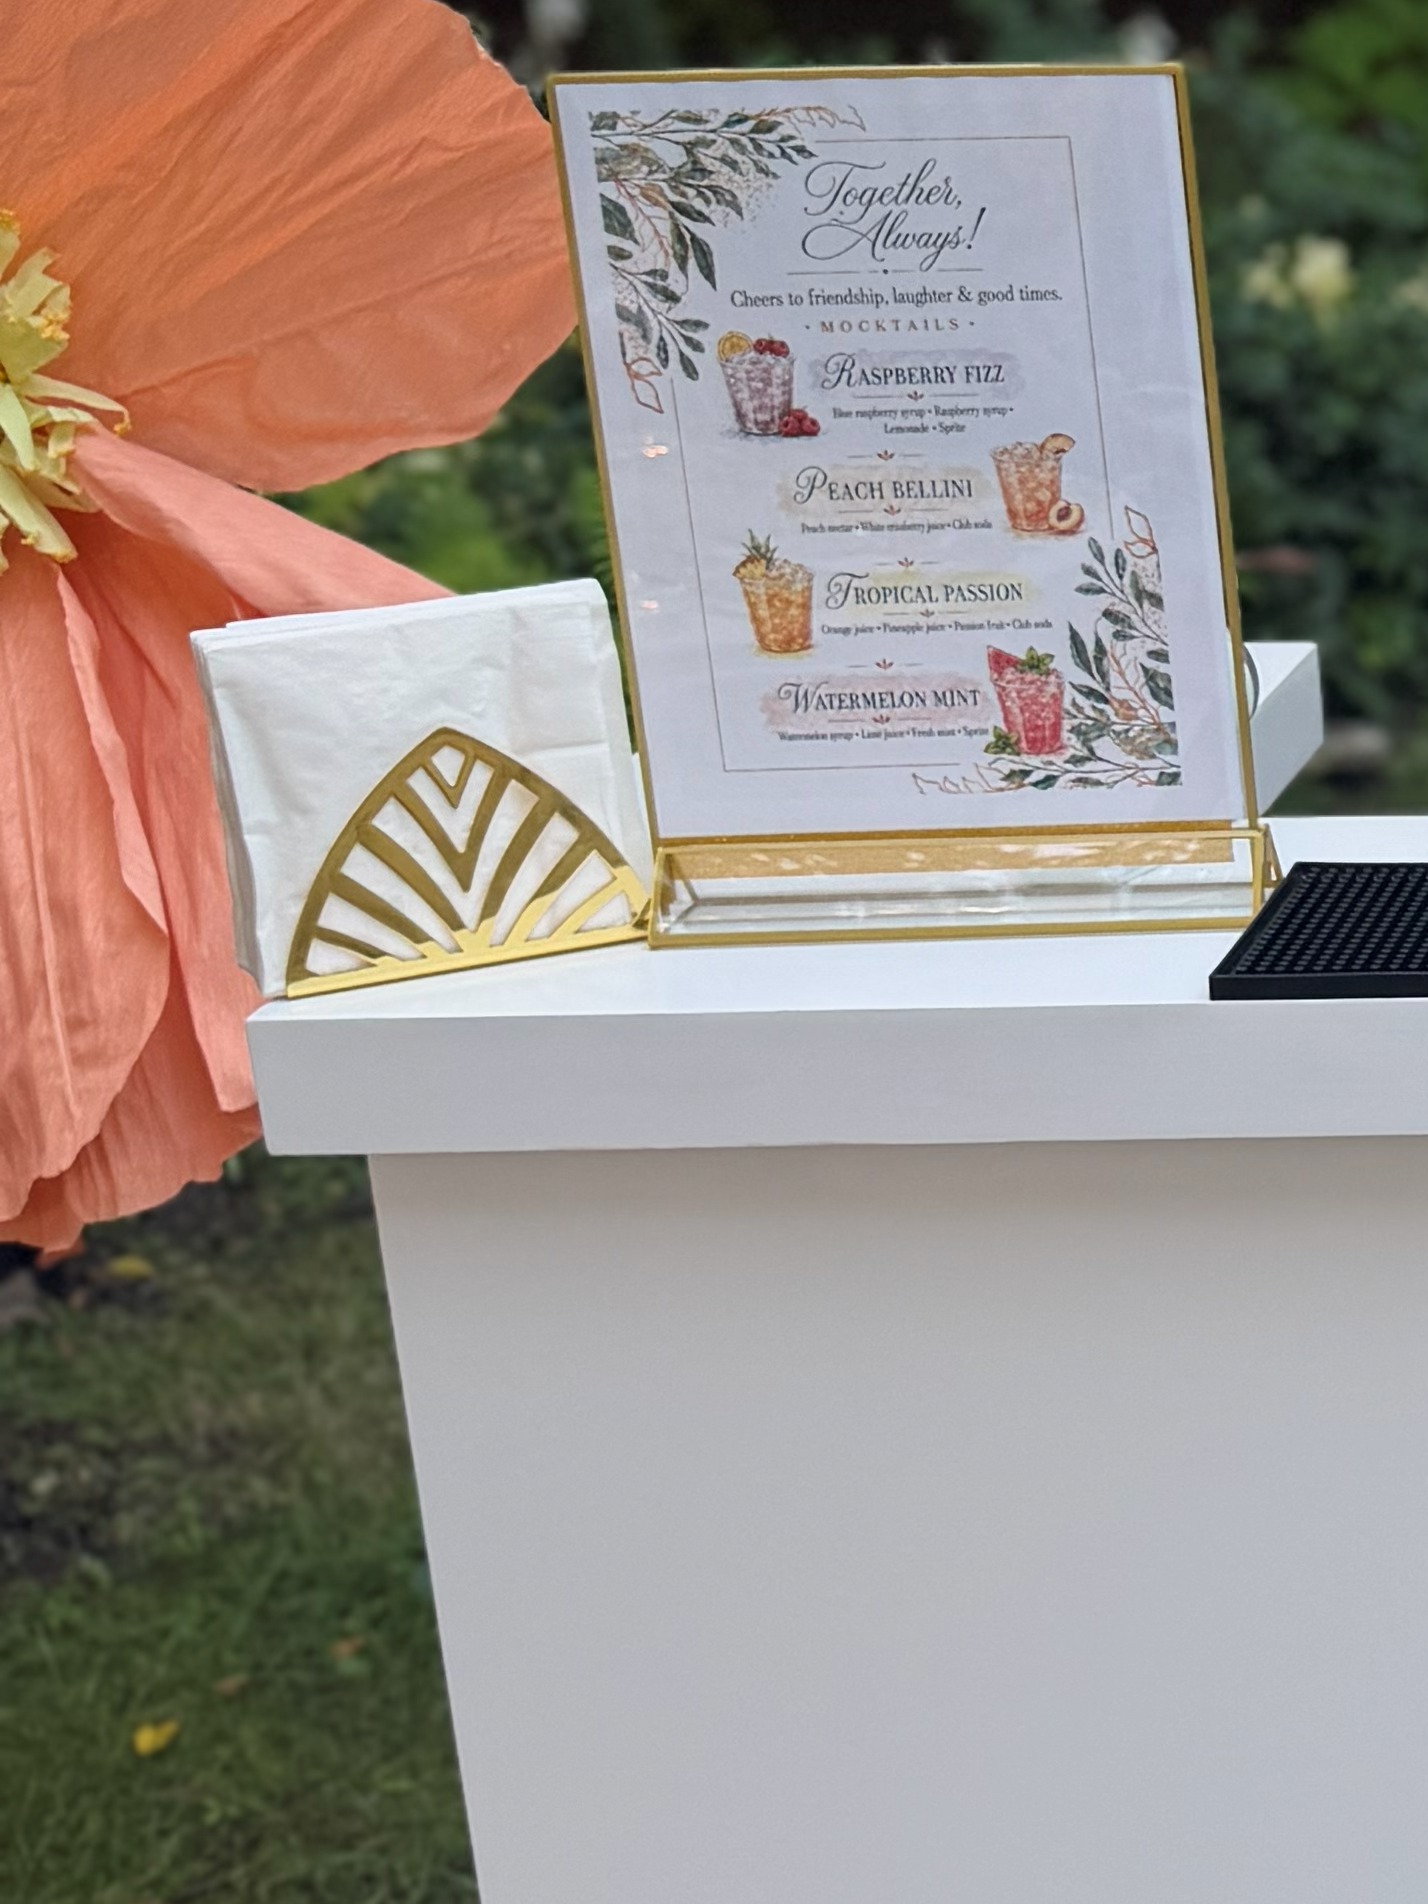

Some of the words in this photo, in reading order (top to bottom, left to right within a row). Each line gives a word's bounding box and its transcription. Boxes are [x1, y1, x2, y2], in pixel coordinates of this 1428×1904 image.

[804, 158, 962, 224] Together,
[801, 207, 986, 272] Always!
[730, 289, 784, 307] Cheers
[788, 291, 804, 306] to
[808, 288, 889, 309] friendship,
[892, 286, 953, 308] laughter
[957, 288, 972, 302] &
[977, 285, 1015, 306] good
[1019, 284, 1063, 302] times.
[820, 317, 960, 333] MOCKTAILS
[821, 352, 956, 389] RASPBERRY
[964, 364, 1005, 384] FIZZ
[884, 423, 929, 434] Lemonade
[939, 422, 966, 435] Sprite
[793, 465, 884, 504] PEACH
[892, 479, 973, 499] BELLINI
[825, 572, 939, 610] TROPICAL
[944, 583, 1023, 602] PASSION
[778, 681, 927, 714] WATERMELON
[933, 689, 980, 708] MINT
